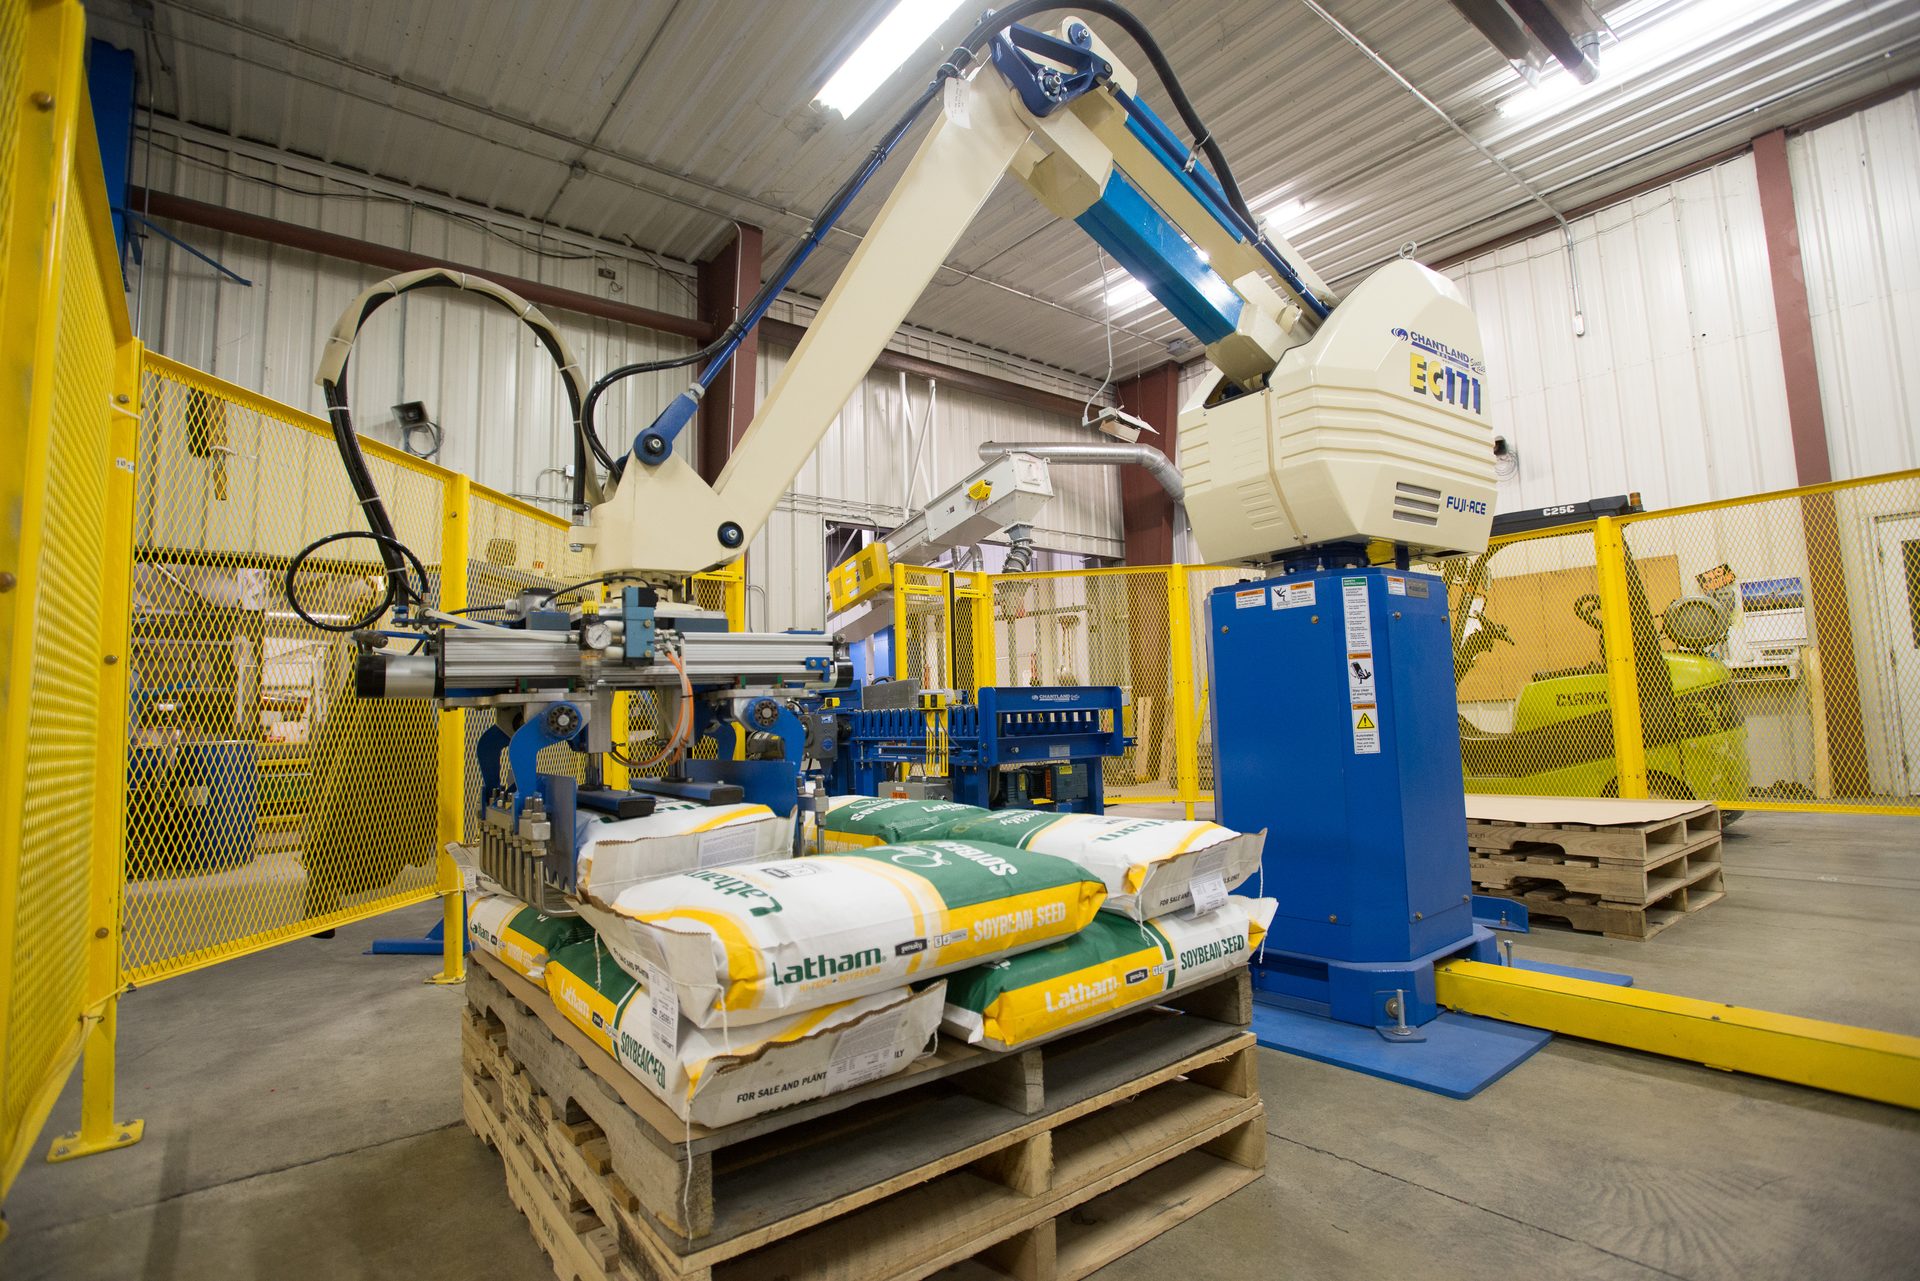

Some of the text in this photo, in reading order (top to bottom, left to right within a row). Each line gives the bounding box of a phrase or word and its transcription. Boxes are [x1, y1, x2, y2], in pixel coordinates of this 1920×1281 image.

[1410, 331, 1469, 363] CHANTLAND
[1409, 352, 1481, 415] EC171
[1446, 496, 1486, 515] FUJI-ACE
[1543, 505, 1575, 517] C25C
[974, 909, 1033, 942] SOYBEAN
[1037, 902, 1066, 927] SEED
[772, 947, 881, 986] Latham
[1180, 934, 1245, 970] SOYBEAN SEED
[560, 978, 590, 1020] Latham
[1045, 976, 1117, 1013] Latham
[736, 1093, 756, 1104] FOR
[757, 1084, 780, 1098] SALE
[781, 1079, 800, 1092] AND
[801, 1072, 828, 1086] PLANT
